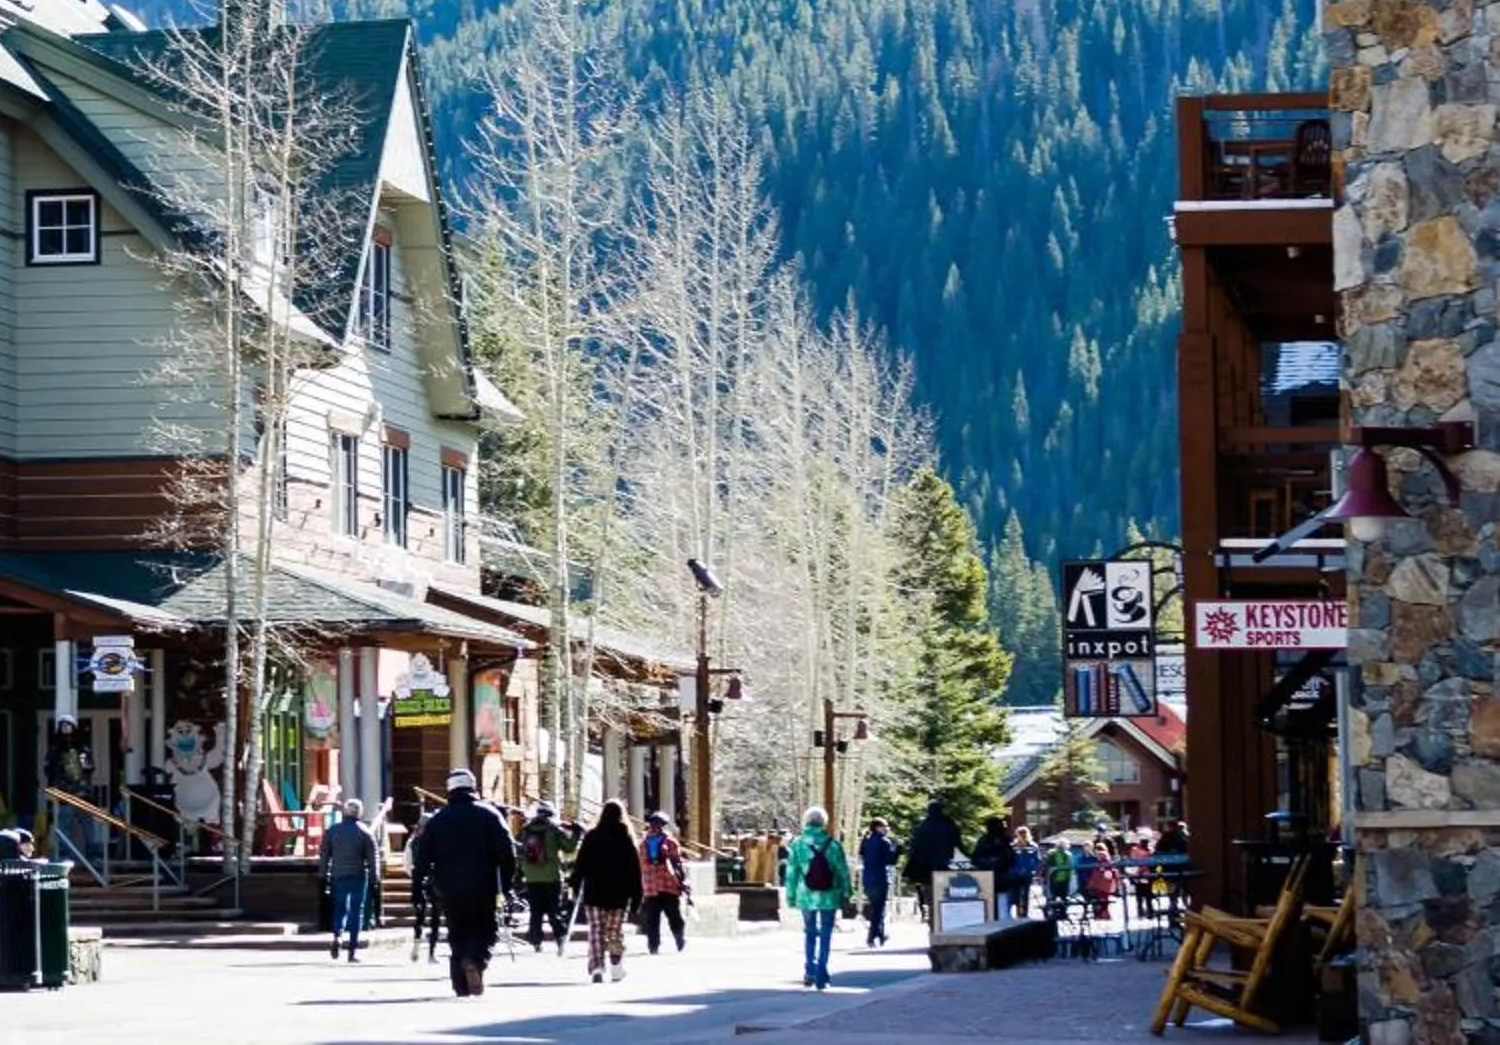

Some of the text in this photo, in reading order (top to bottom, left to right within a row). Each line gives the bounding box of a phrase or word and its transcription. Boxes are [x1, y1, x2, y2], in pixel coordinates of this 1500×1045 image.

[1245, 603, 1347, 629] KEYSTONE
[1067, 634, 1149, 659] inxpot
[1246, 630, 1301, 646] SPORTS
